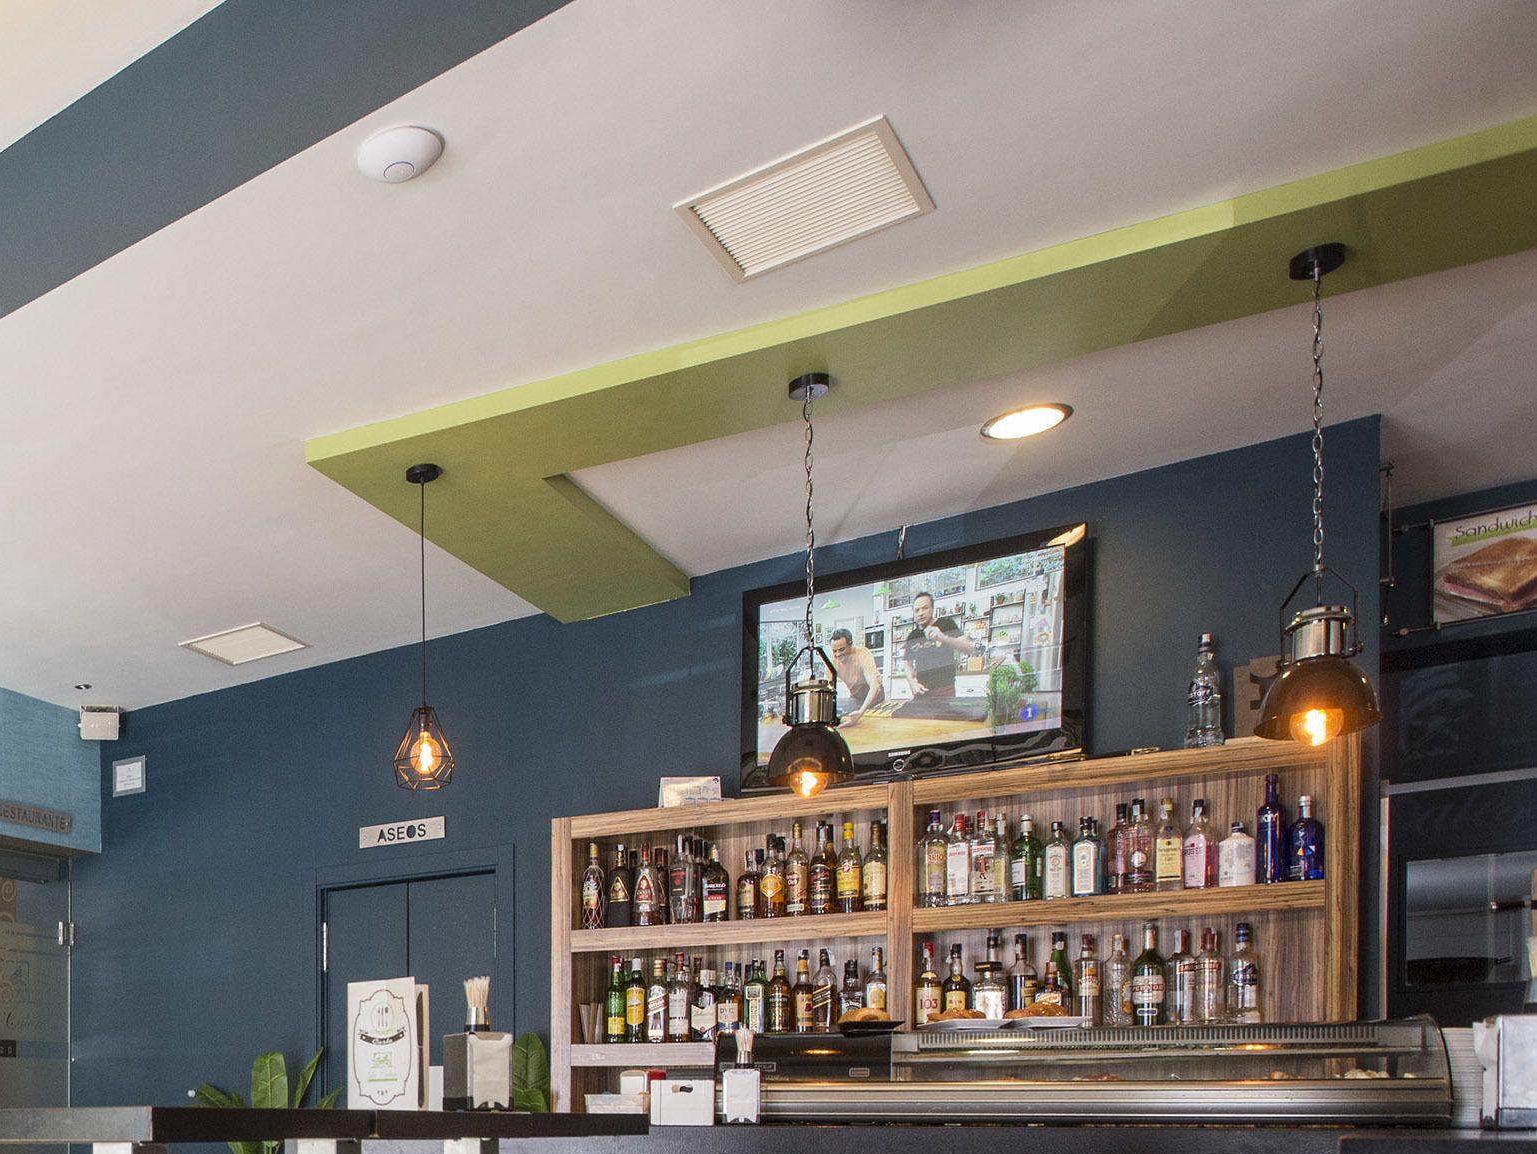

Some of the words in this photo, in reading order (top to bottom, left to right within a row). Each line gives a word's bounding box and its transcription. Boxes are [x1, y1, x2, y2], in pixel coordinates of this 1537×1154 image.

[888, 750, 911, 758] SAMSUNG
[377, 823, 426, 843] ASEOS
[919, 998, 938, 1010] 103
